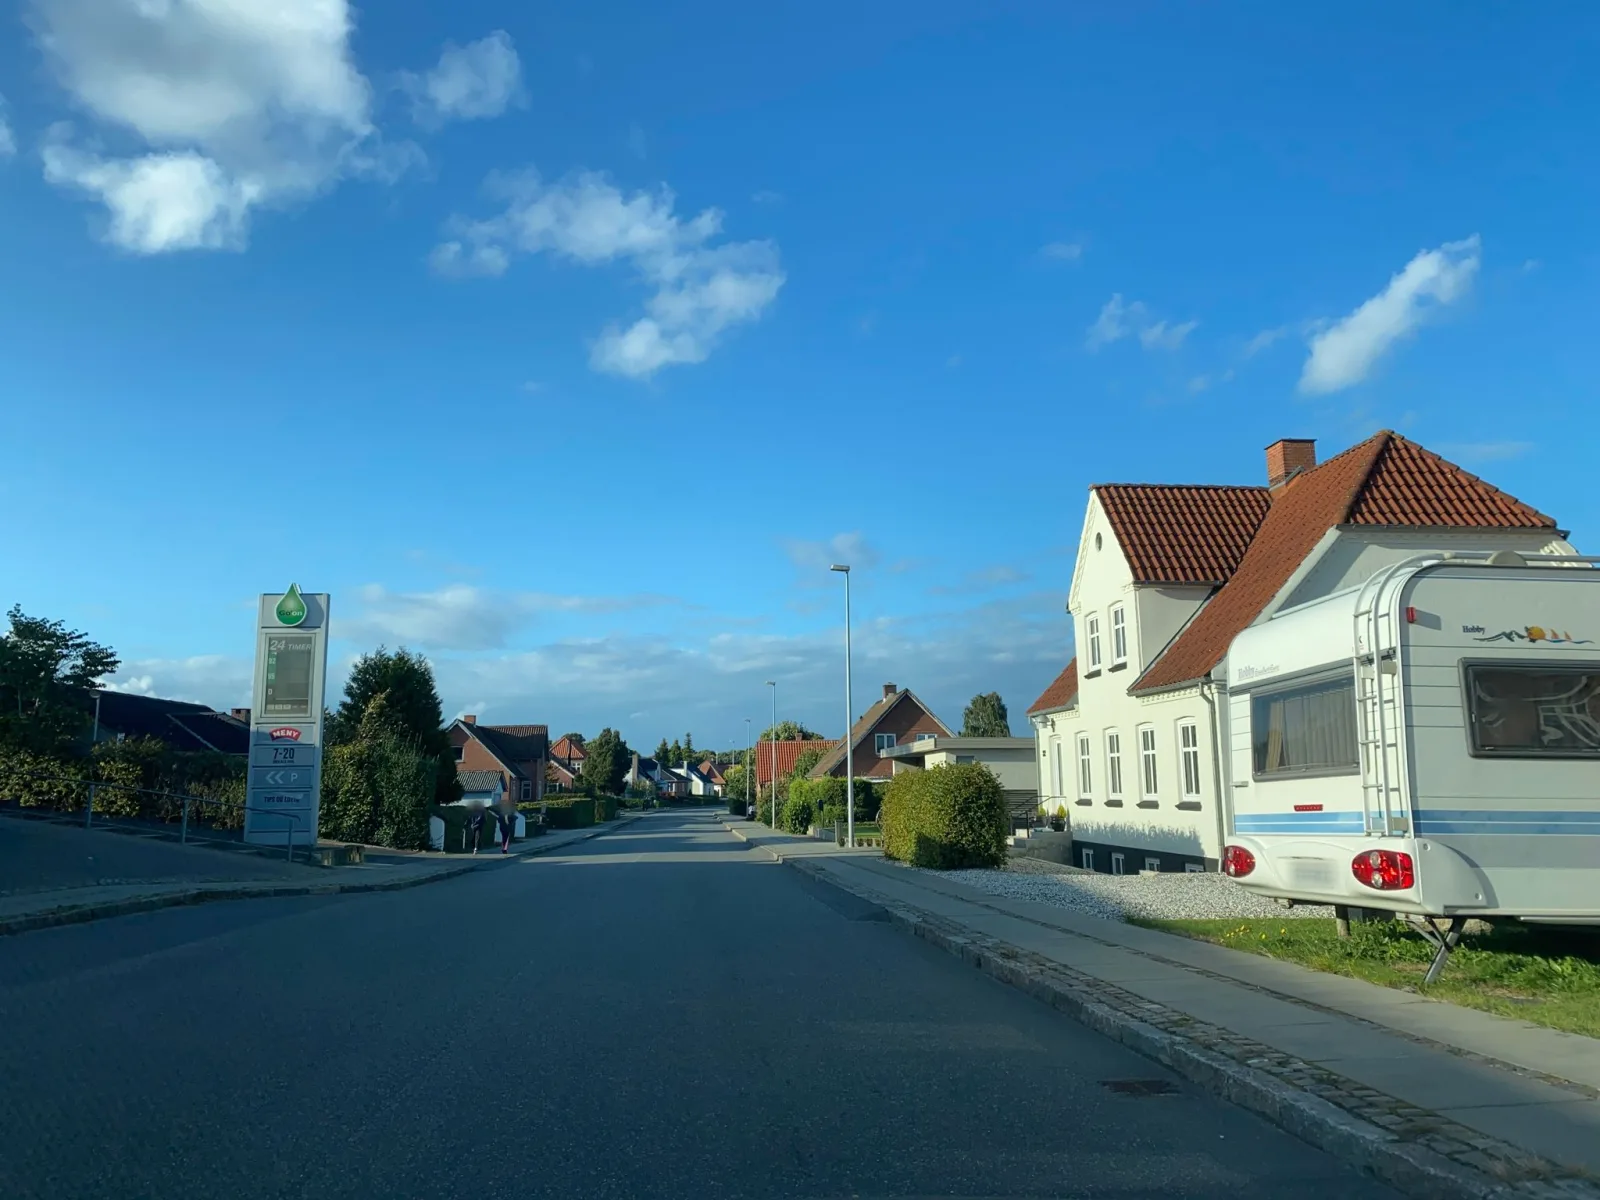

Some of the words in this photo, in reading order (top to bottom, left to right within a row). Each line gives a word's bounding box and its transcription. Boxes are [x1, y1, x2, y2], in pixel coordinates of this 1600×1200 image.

[1462, 625, 1486, 635] Hobby
[270, 640, 286, 650] 24
[272, 729, 299, 738] MENY
[274, 748, 295, 759] 7-20
[291, 773, 298, 782] P
